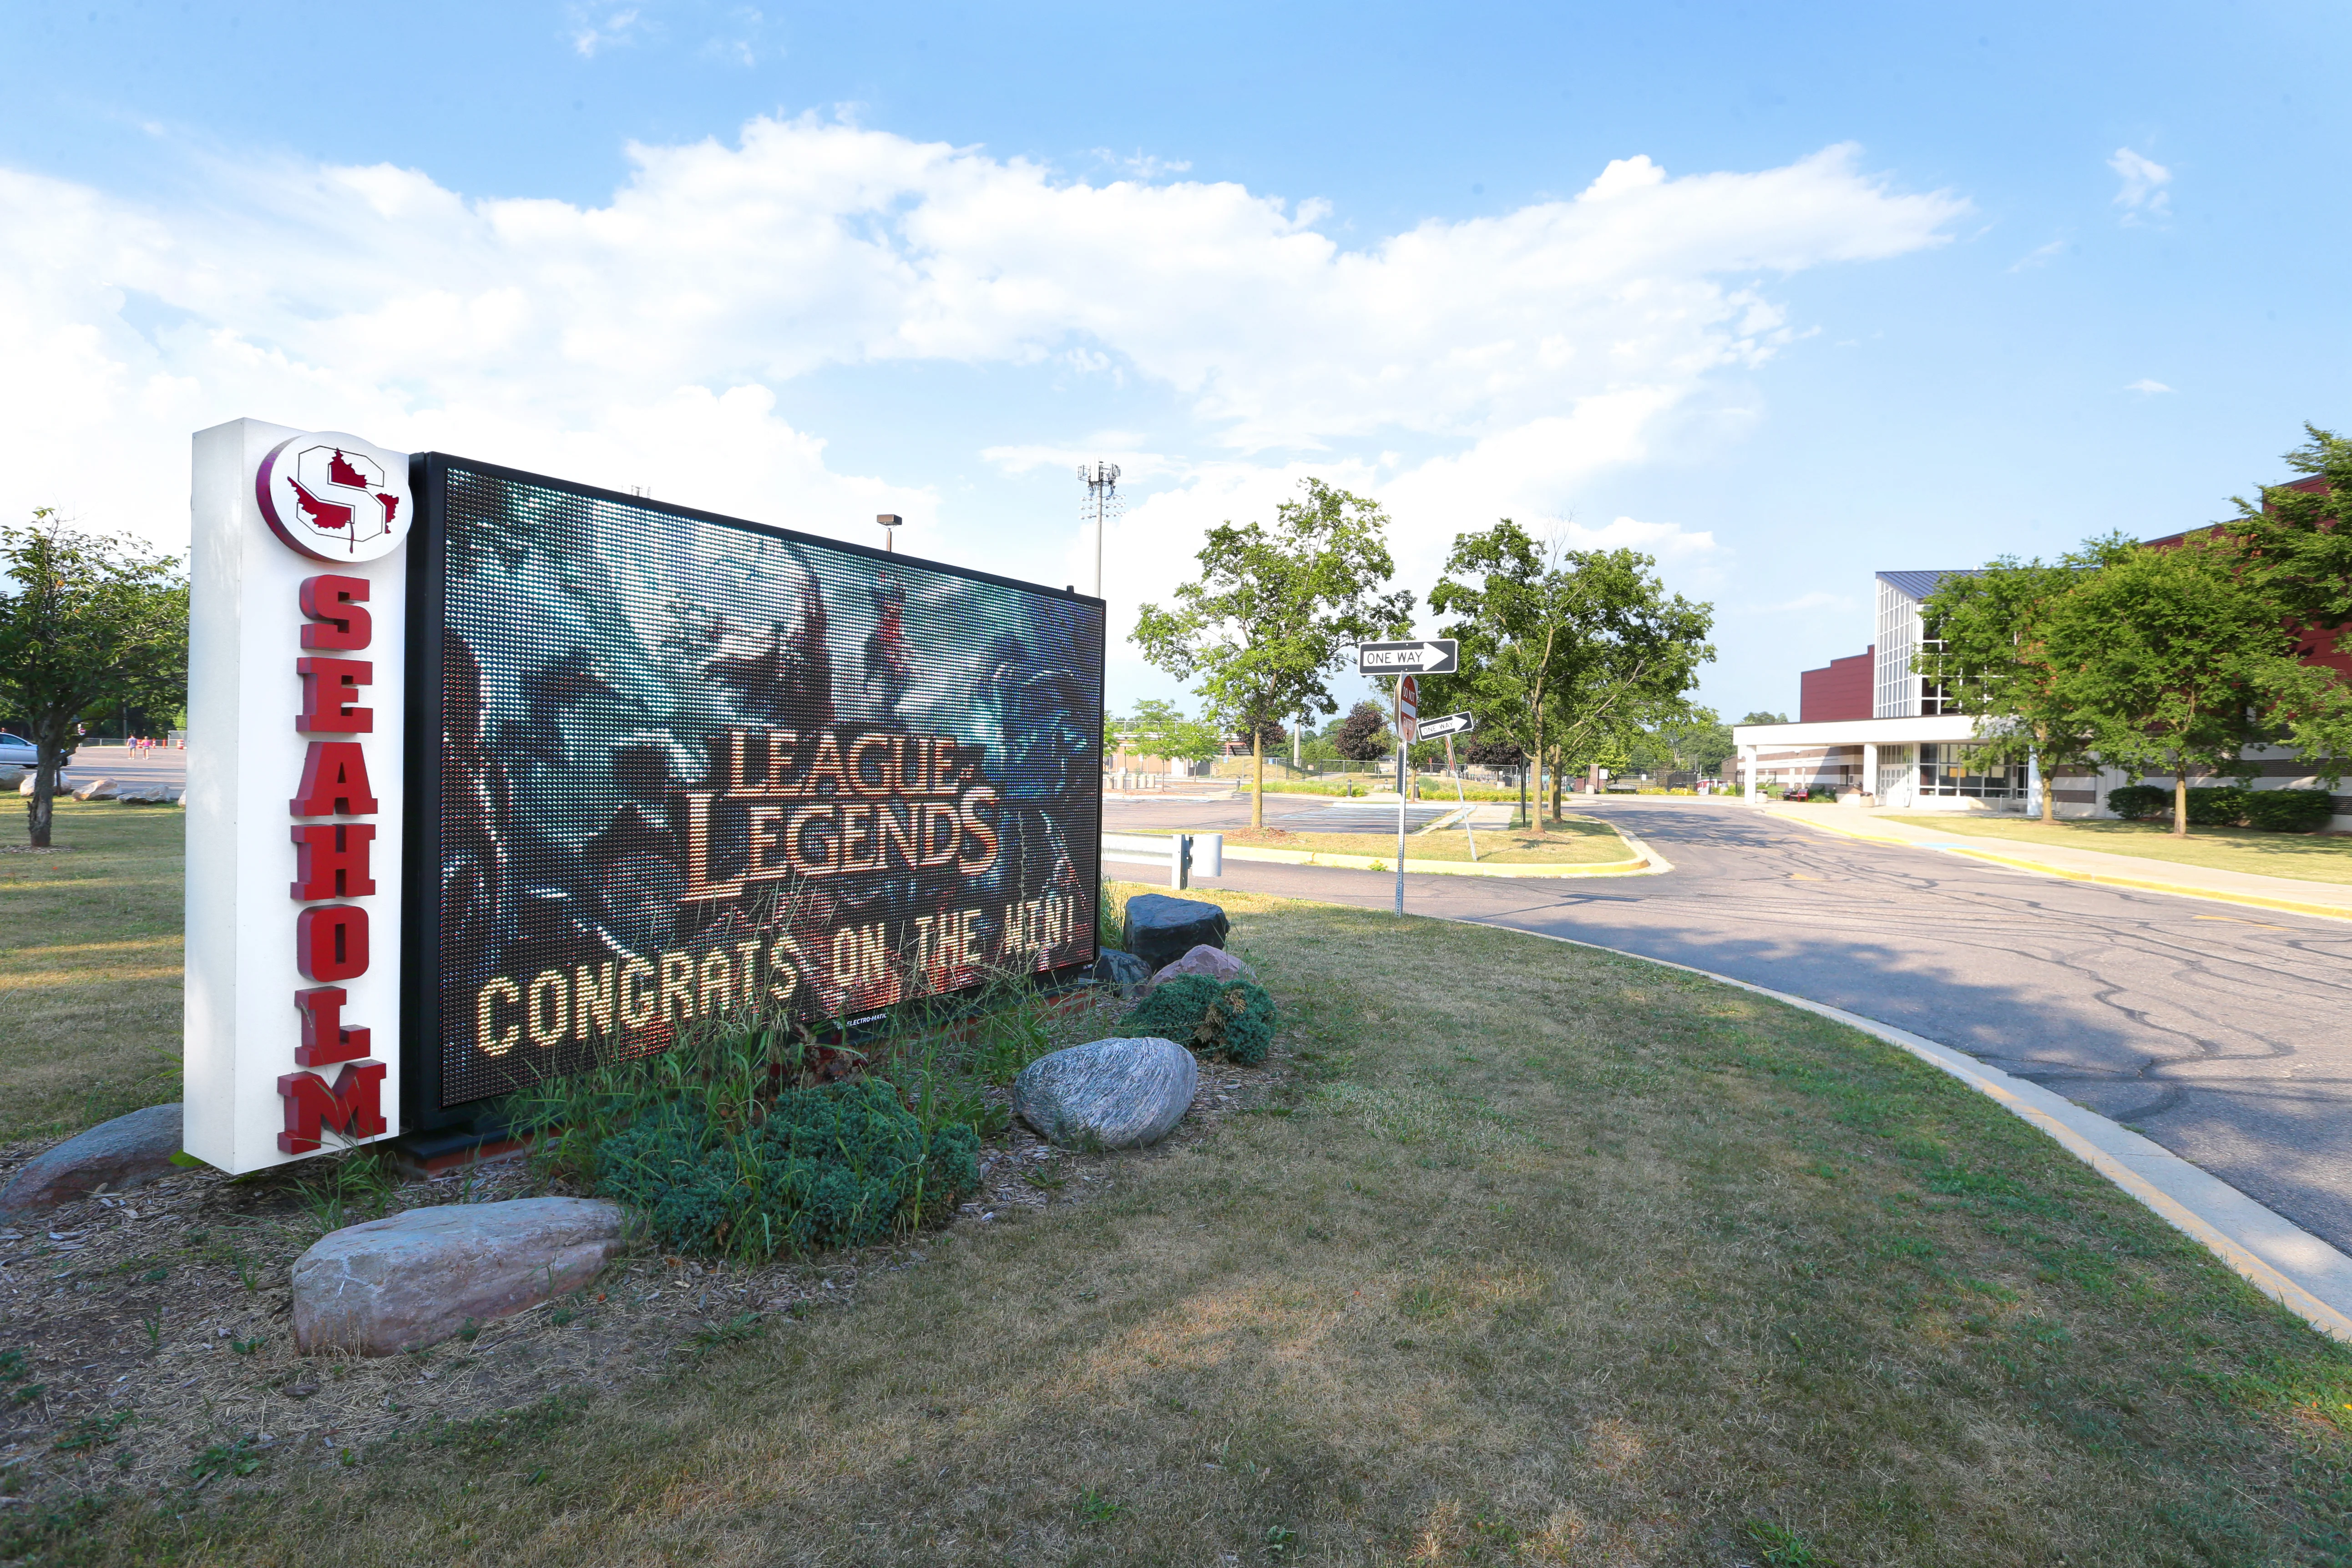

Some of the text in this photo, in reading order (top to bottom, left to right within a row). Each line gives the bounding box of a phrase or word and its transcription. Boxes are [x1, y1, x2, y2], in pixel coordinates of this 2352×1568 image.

[1367, 651, 1423, 664] ONE WAY
[1403, 686, 1408, 699] DO
[1403, 716, 1414, 732] ENTER
[1423, 721, 1453, 734] ONE WAY
[723, 729, 959, 797] LEAGUE
[680, 785, 999, 901] LEGENDS
[277, 574, 386, 1156] SEAHOLM
[477, 895, 1073, 1057] CONGRATS ON THE WIN!
[846, 1013, 887, 1027] ELECTRO-MATIC
